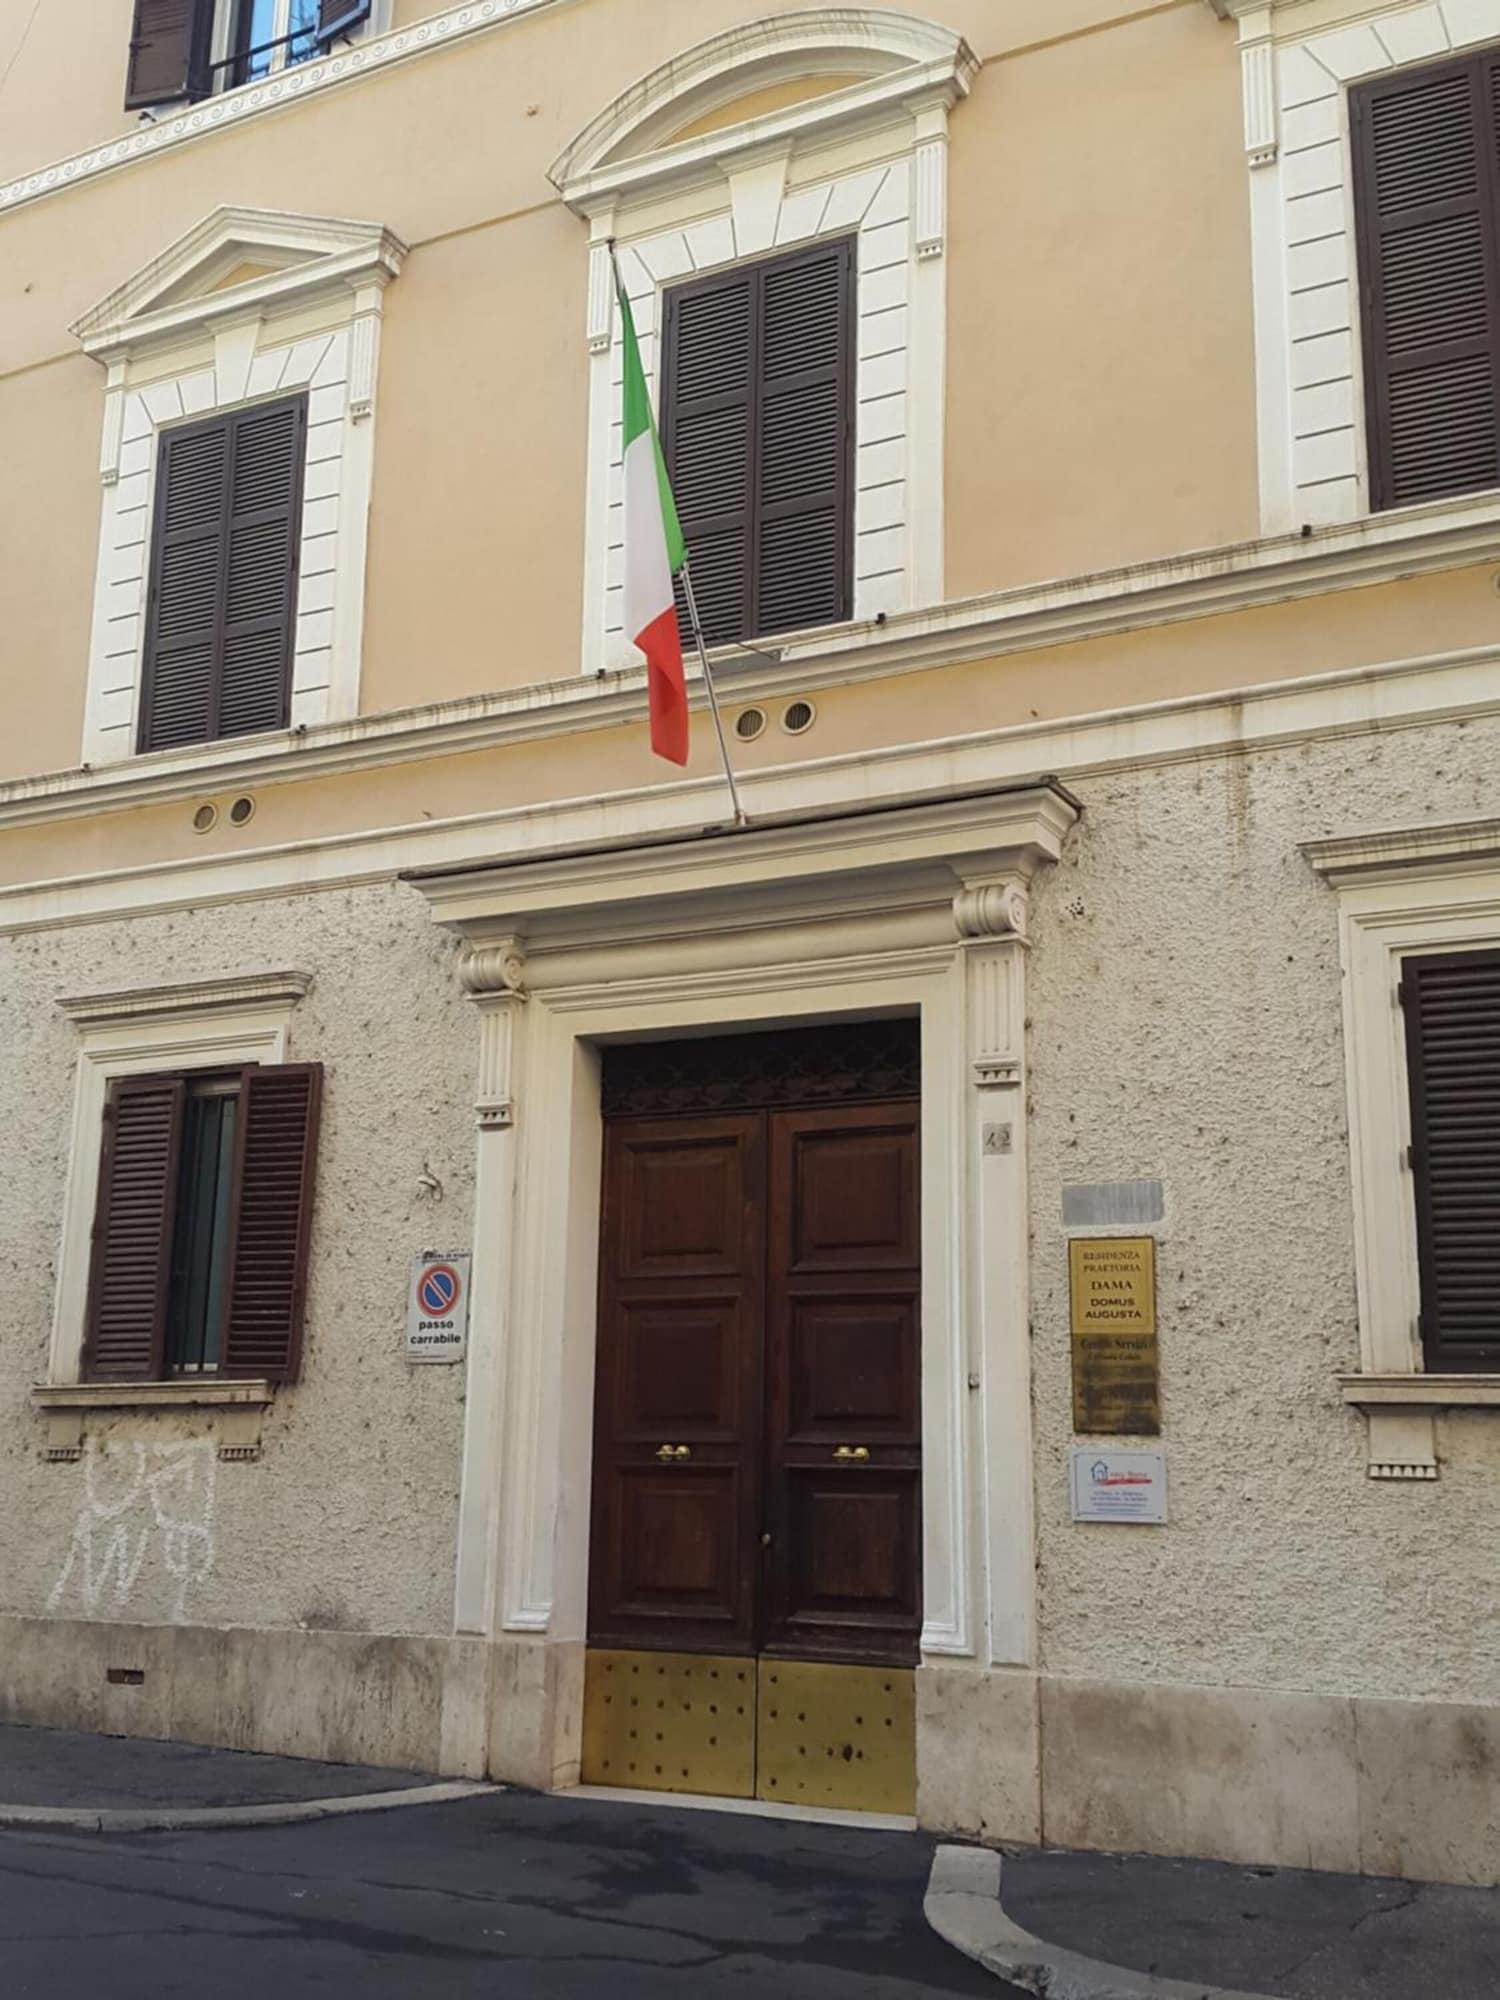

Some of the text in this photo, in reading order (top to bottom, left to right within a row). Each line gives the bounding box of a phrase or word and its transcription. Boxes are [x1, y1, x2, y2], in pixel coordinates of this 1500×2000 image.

[1083, 1264, 1142, 1272] PRAETORIA
[1091, 1281, 1133, 1290] DAMA
[1090, 1298, 1136, 1307] DOMUS
[1085, 1311, 1142, 1319] AUGUSTA
[419, 1320, 454, 1332] passo
[410, 1334, 462, 1344] carrabile
